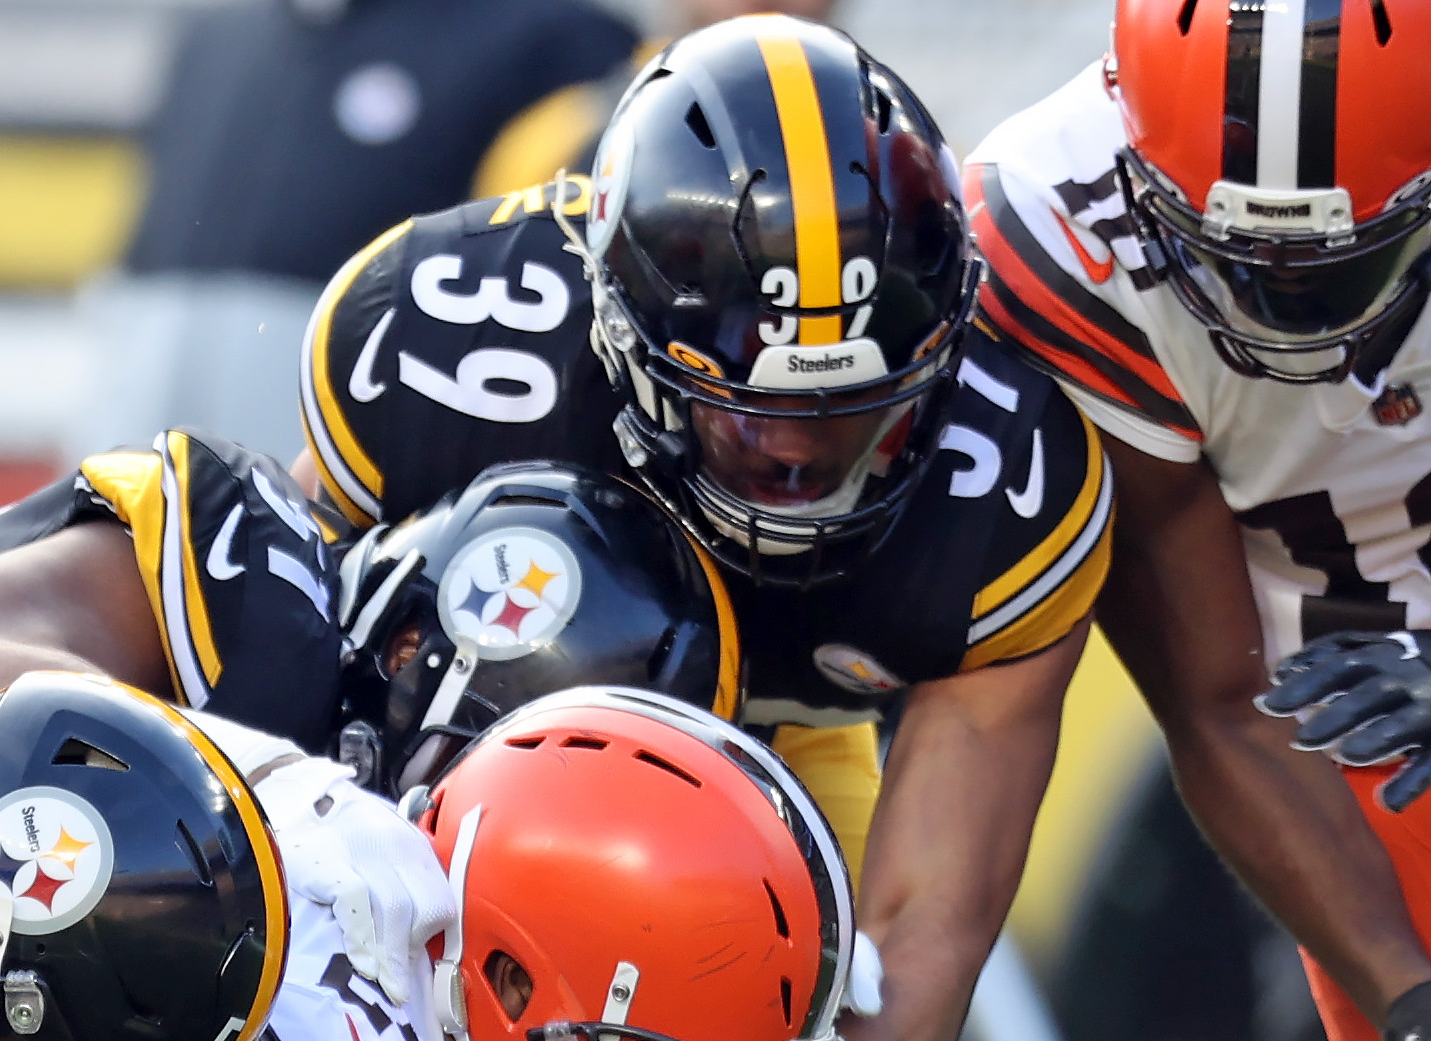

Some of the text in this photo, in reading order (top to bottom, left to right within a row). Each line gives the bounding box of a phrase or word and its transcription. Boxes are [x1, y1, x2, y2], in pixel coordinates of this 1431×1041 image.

[758, 256, 878, 346] 39
[399, 255, 570, 423] 39
[787, 353, 855, 373] Steelers
[21, 805, 40, 853] Steelers
